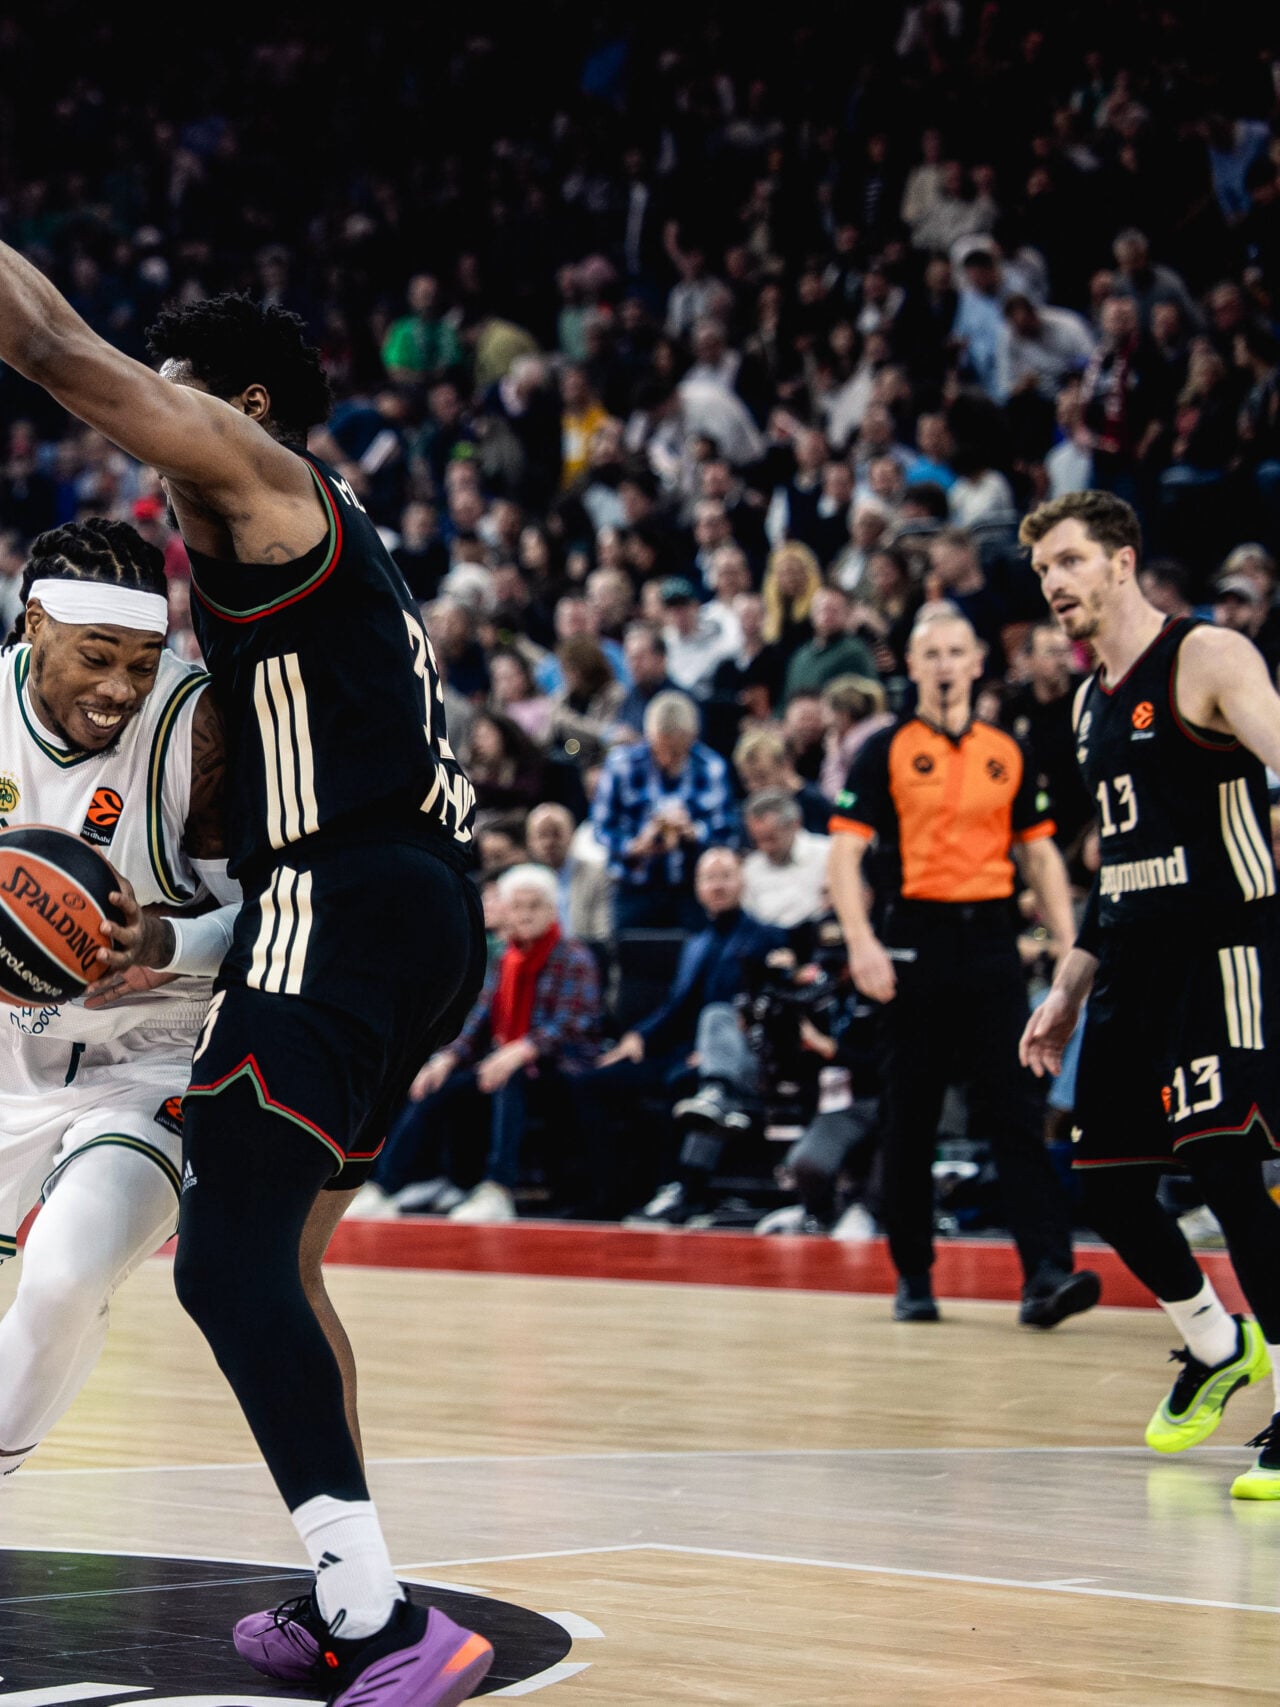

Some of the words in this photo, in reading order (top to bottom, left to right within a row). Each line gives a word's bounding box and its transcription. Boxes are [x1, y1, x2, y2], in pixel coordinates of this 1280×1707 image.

[1096, 773, 1138, 838] 13
[1099, 846, 1188, 903] gmund
[1172, 1055, 1223, 1123] 13
